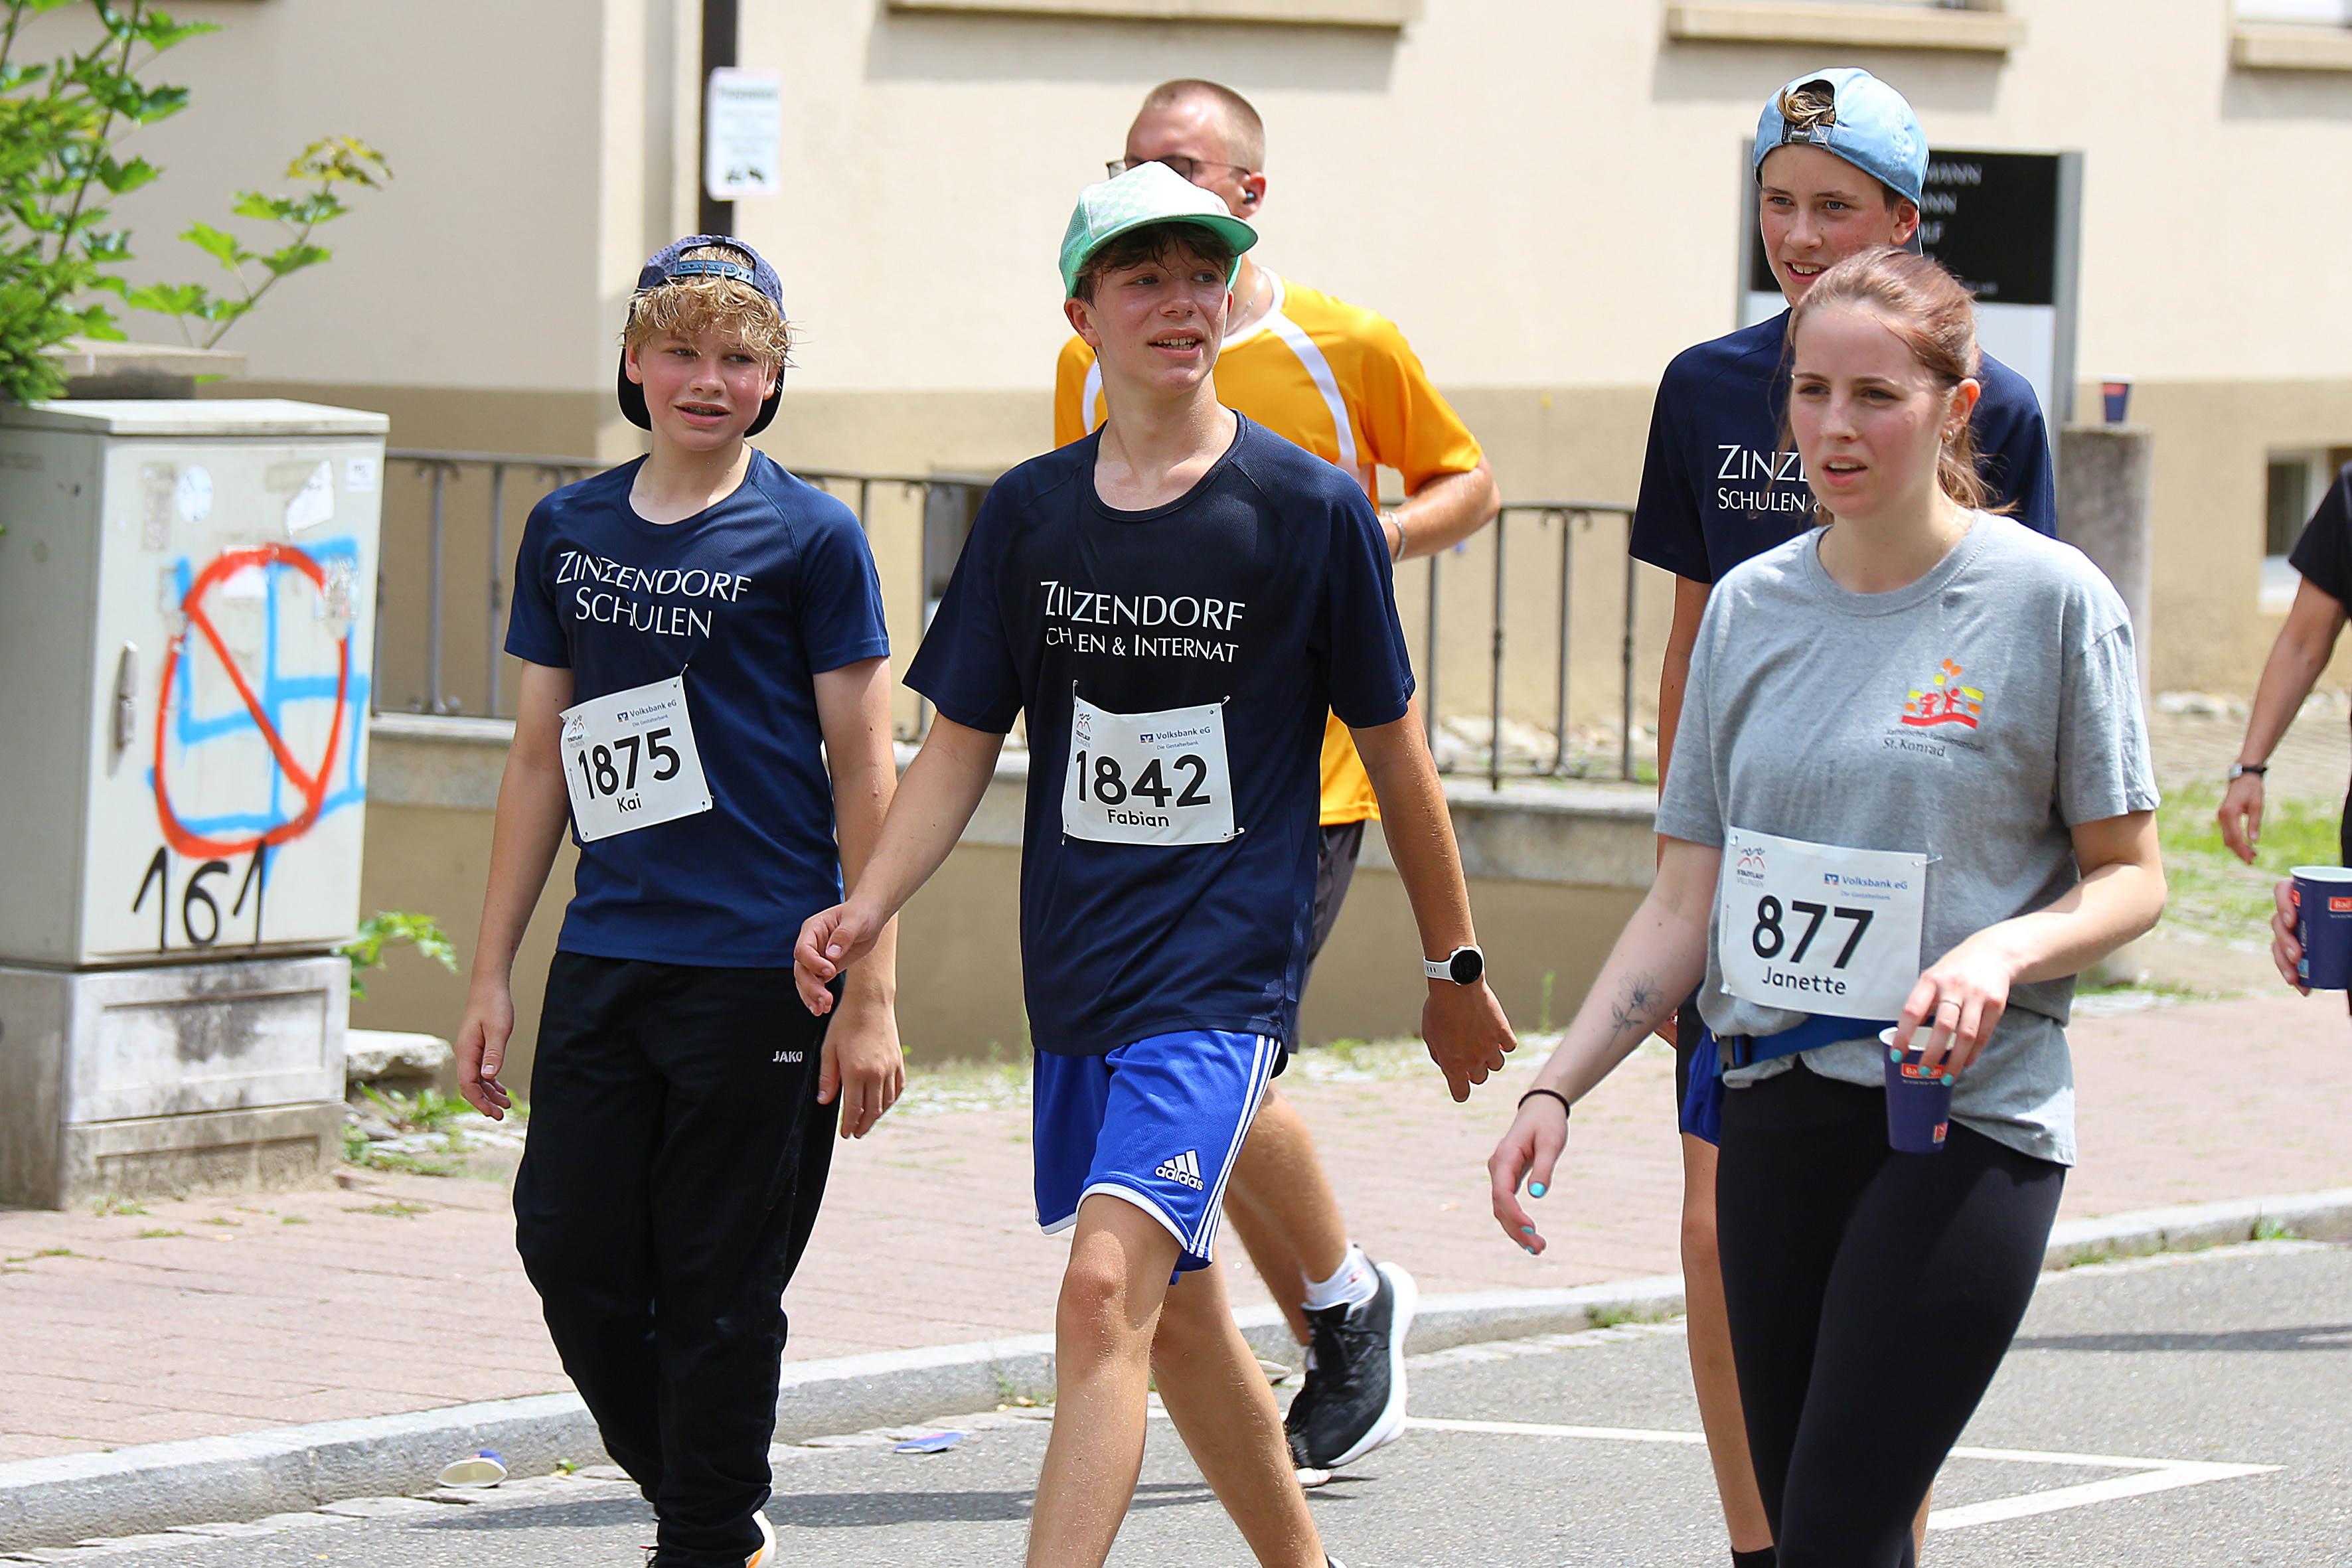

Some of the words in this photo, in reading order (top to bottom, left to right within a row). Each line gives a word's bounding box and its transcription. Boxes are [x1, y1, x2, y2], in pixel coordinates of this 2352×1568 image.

[1717, 487, 1806, 512] SCHULEN
[556, 550, 751, 603] ZINZENDORF
[576, 587, 712, 639] SCHULEN
[1112, 637, 1126, 656] &
[1135, 634, 1239, 663] INTERNAT
[629, 702, 666, 717] Volksbank
[1156, 728, 1198, 740] Volksbank
[1166, 740, 1199, 749] Gestalterbank
[1900, 739, 1946, 757] Konrad
[578, 727, 681, 800] 1875
[1076, 750, 1211, 808] 1842
[617, 793, 641, 813] Kai
[1107, 809, 1169, 826] Fabian
[1842, 876, 1891, 888] Volksbank
[1895, 880, 1908, 890] eG
[133, 839, 265, 953] 161
[1753, 895, 1874, 969] 877
[1762, 966, 1847, 995] Janette
[773, 1051, 803, 1062] JAKO
[1155, 1166, 1204, 1191] adidas
